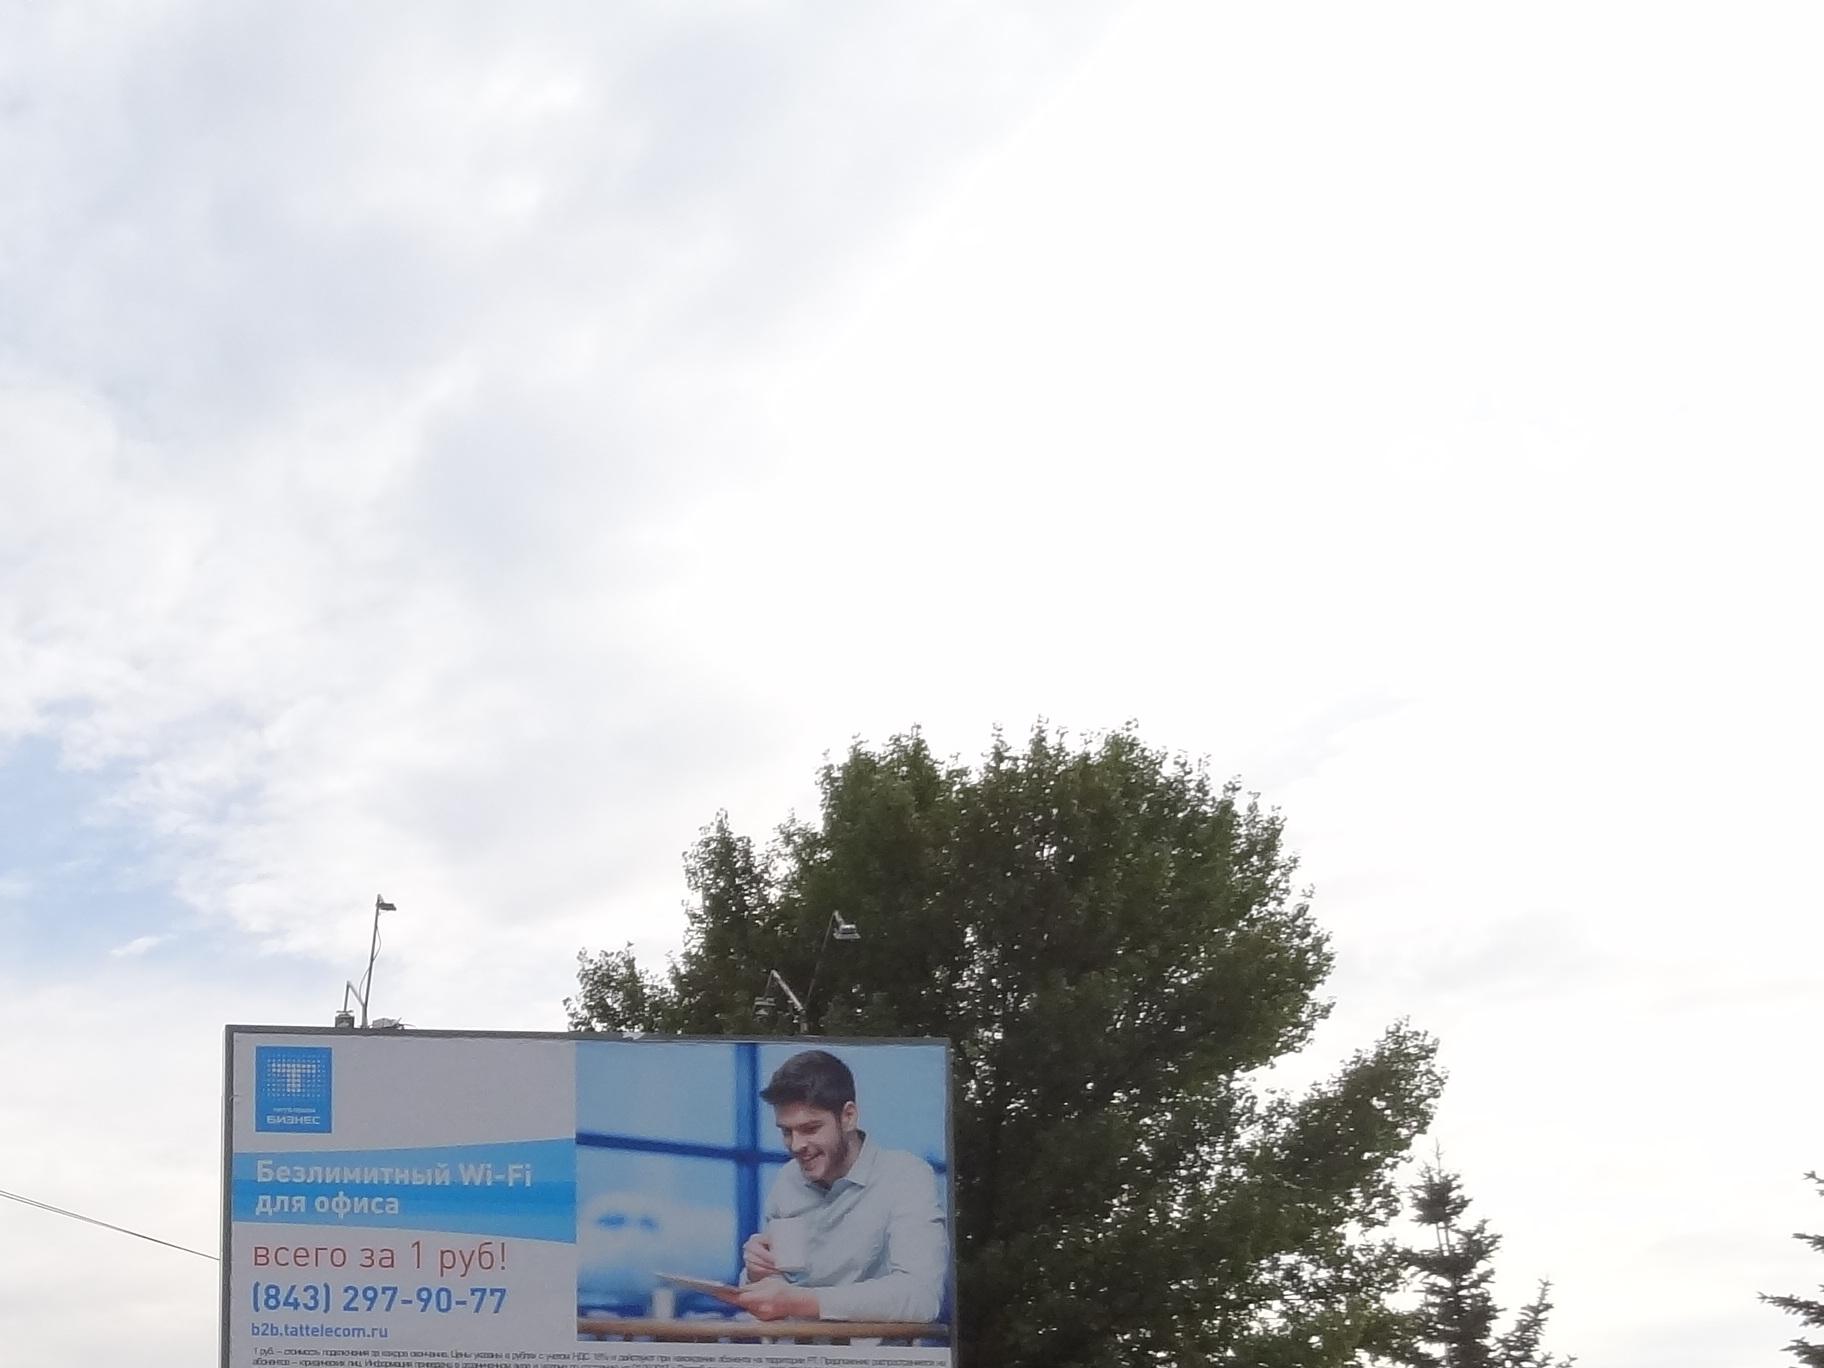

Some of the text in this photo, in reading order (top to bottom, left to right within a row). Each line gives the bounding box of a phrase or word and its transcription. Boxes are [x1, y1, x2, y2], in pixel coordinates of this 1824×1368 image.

[266, 1115, 321, 1125] БИЗНЕС
[256, 1159, 532, 1188] Безлимитный Wi-Fi
[255, 1190, 400, 1219] для офиса
[253, 1240, 506, 1278] всего за 1 руб!
[252, 1281, 508, 1315] (843) 297-90-77
[250, 1322, 389, 1338] b2b.tattelecom.ru
